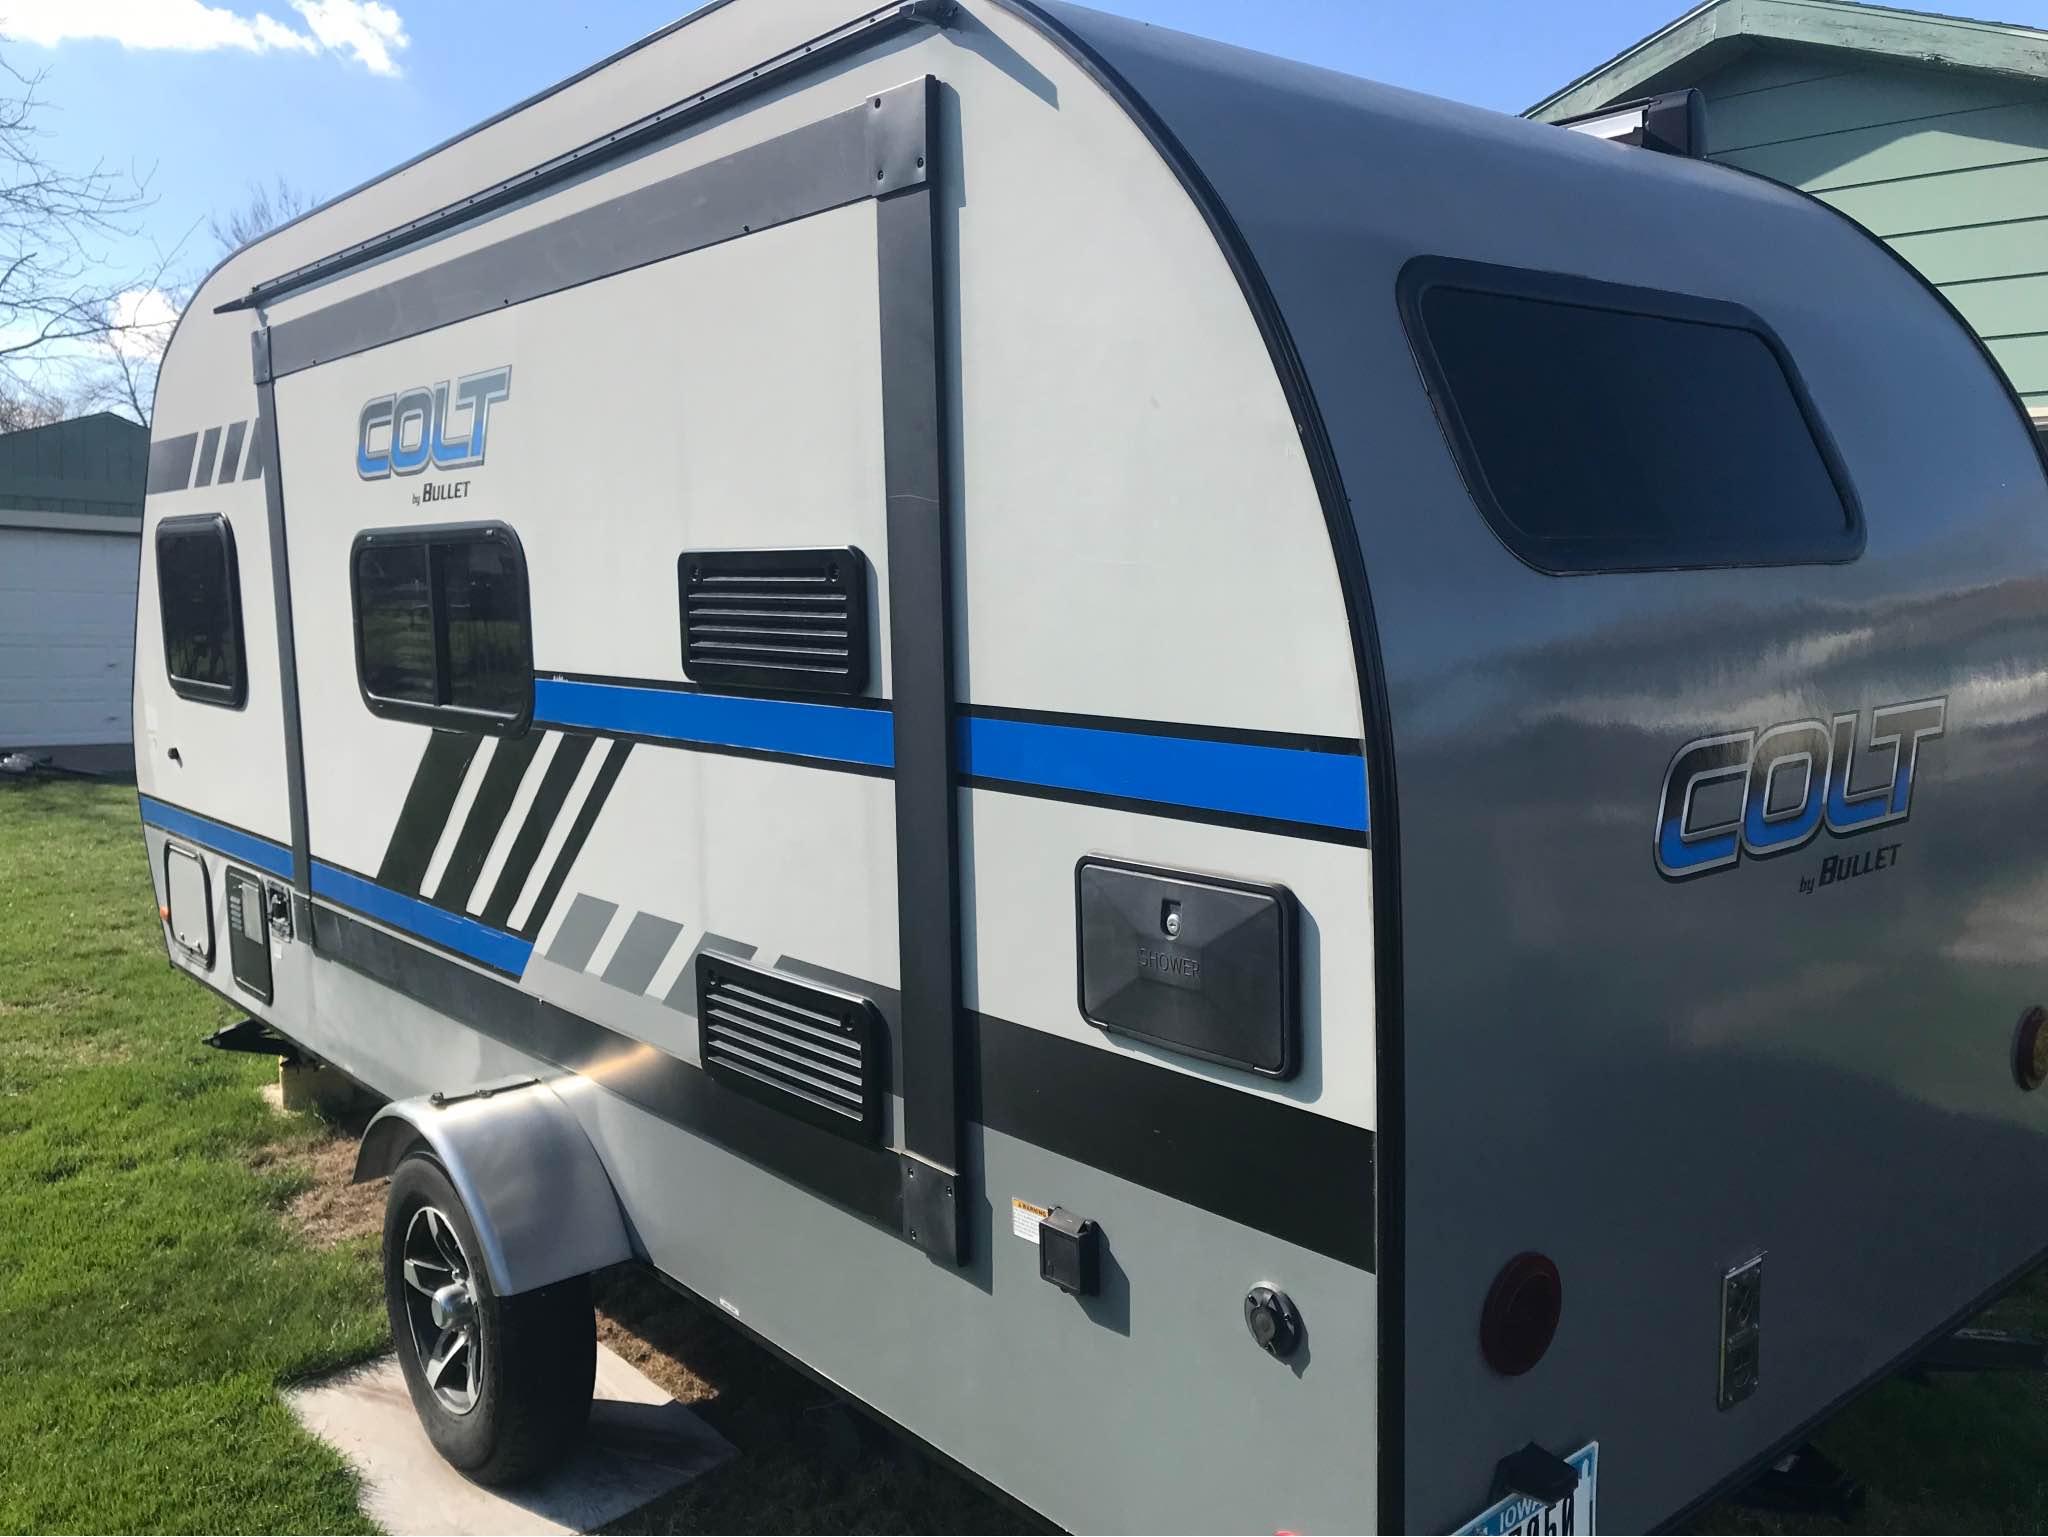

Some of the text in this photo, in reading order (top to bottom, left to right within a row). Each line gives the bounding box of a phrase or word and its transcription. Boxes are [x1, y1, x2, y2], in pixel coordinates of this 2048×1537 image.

[356, 364, 513, 482] COLT
[412, 481, 471, 506] by BULLET
[1653, 695, 1948, 883] COLT
[1799, 844, 1903, 895] by BULLET
[1137, 947, 1201, 979] SHOWER
[1023, 1202, 1047, 1217] WARNING
